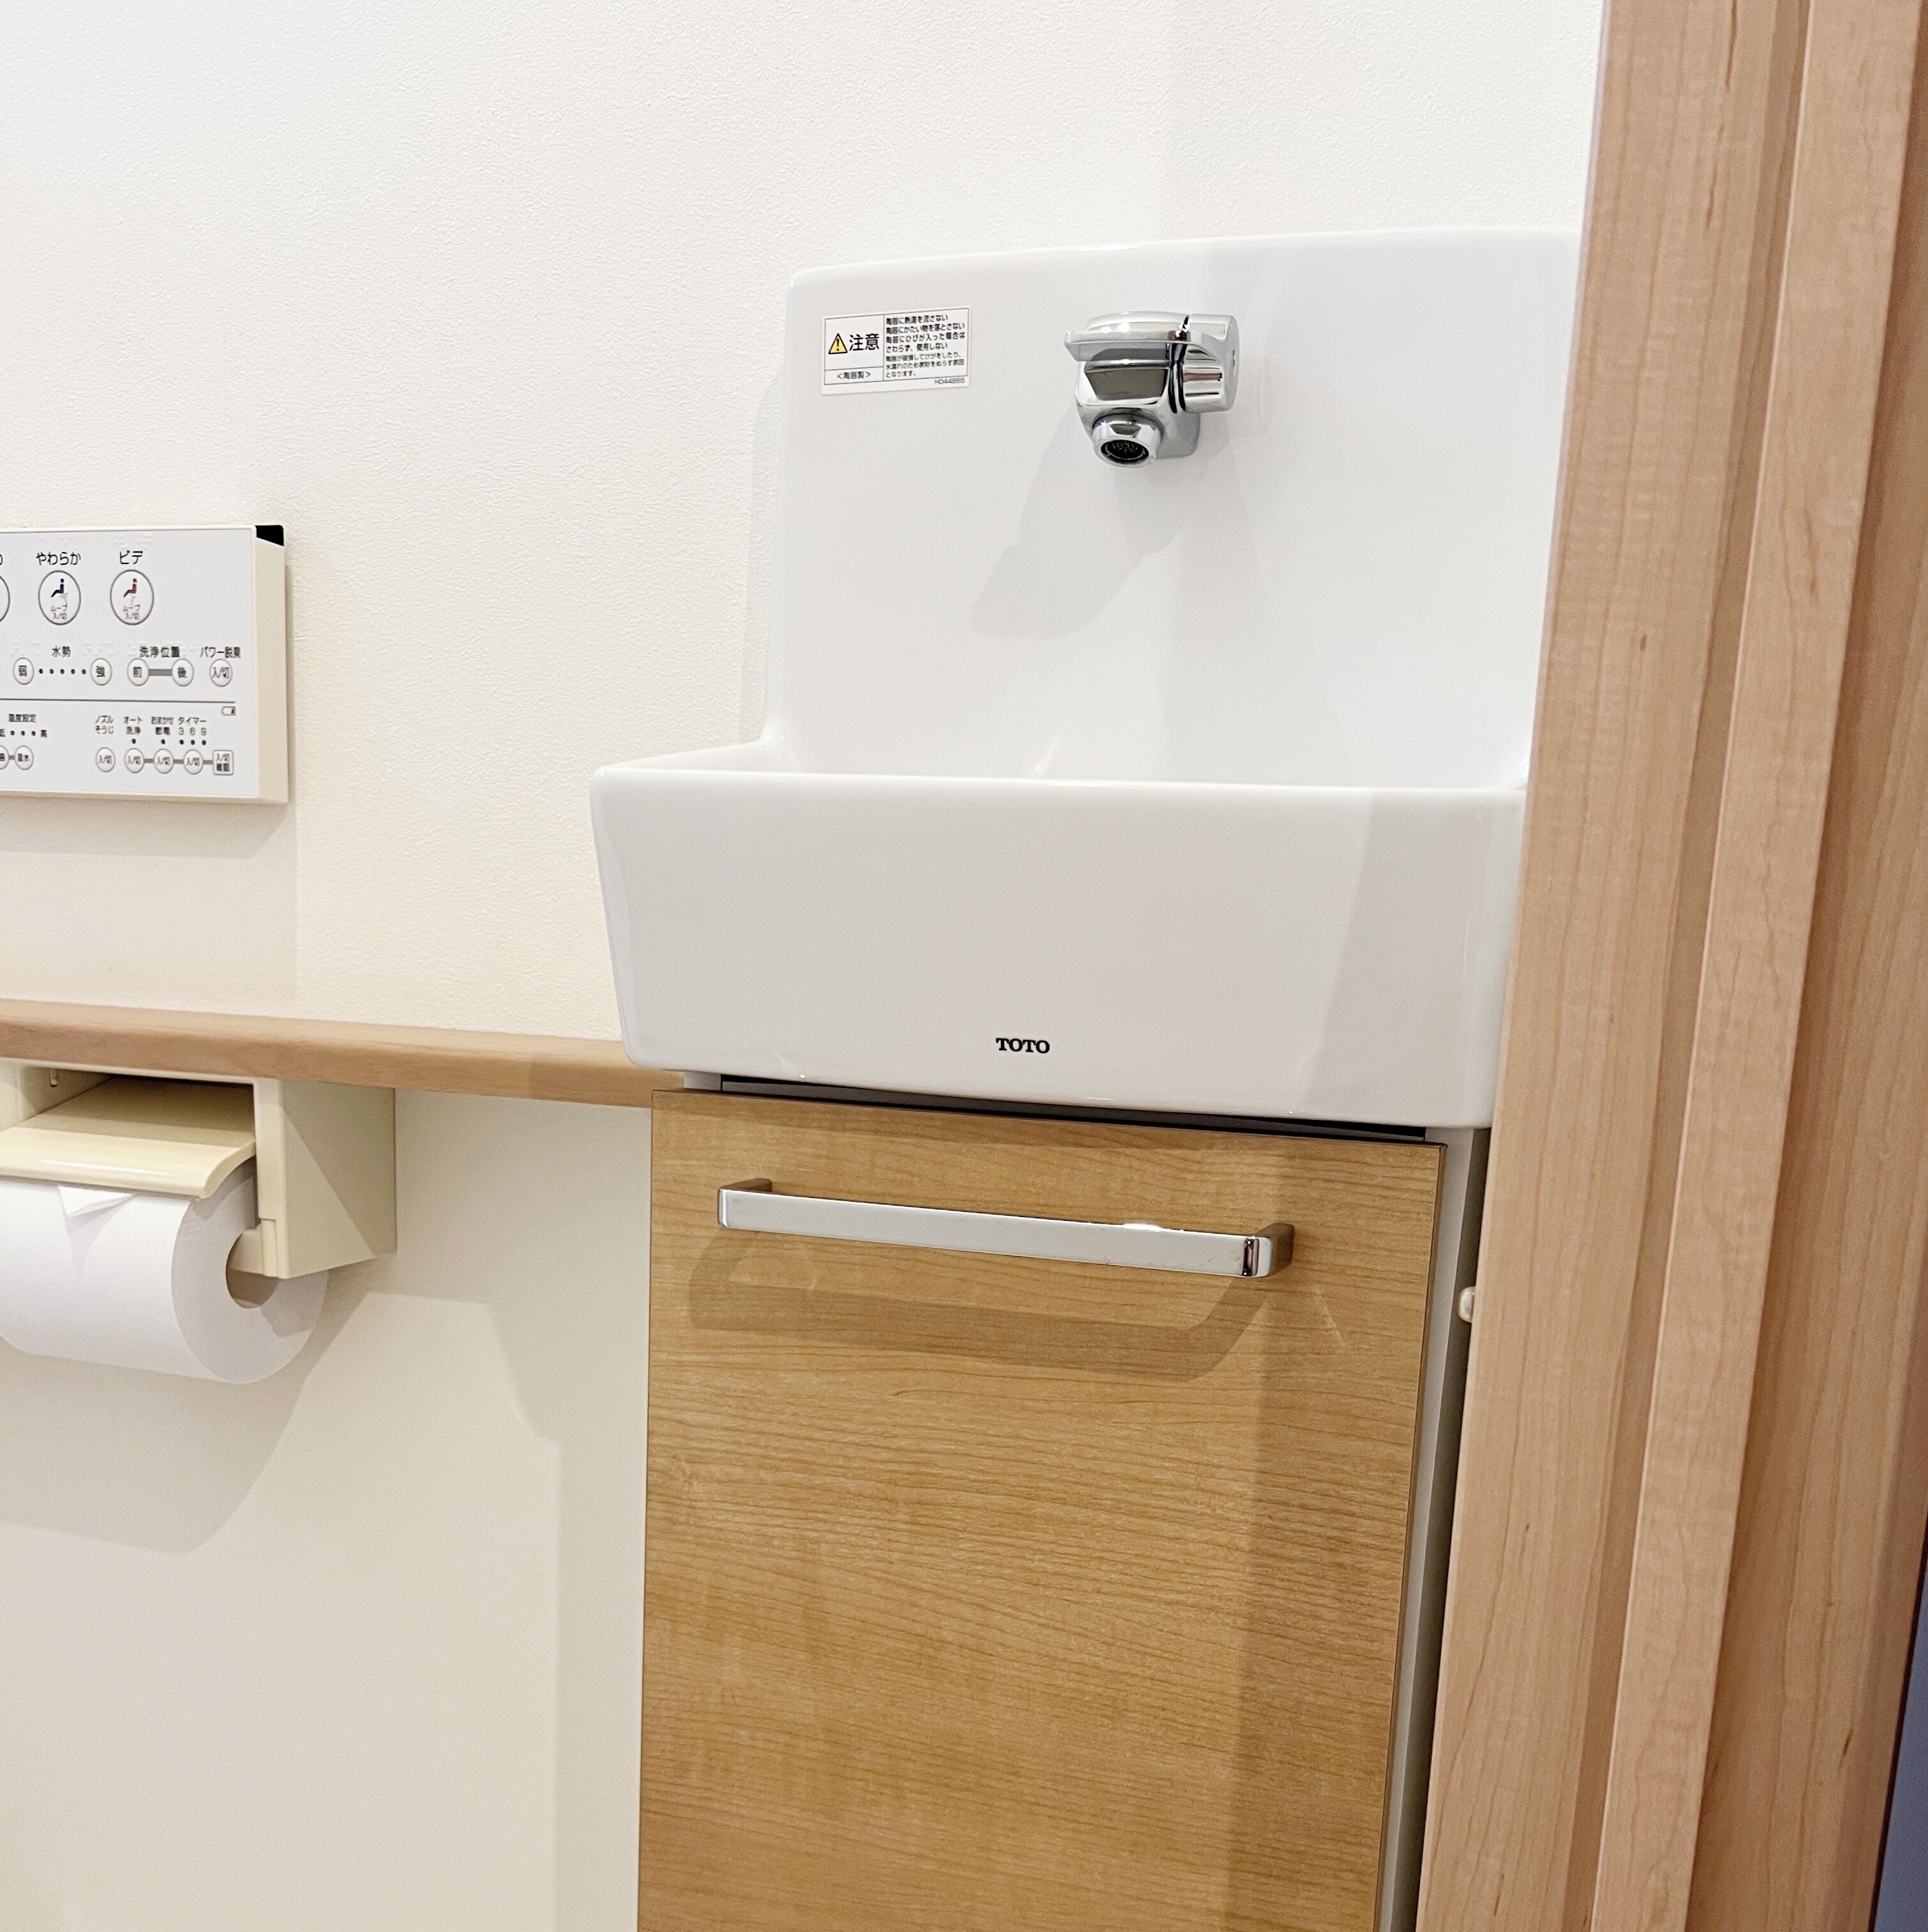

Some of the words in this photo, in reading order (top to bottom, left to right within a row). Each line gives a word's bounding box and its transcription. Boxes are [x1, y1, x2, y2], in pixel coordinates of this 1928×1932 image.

[849, 333, 879, 351] 注意
[886, 332, 965, 343] 陶器にひびが入った場合は
[36, 552, 81, 565] やわらか
[120, 550, 143, 565] ビデ
[52, 646, 71, 657] 水勢
[139, 646, 180, 658] 洗浄位置
[200, 646, 241, 659] パワー脱臭
[96, 666, 105, 677] 強
[133, 666, 142, 678] 前
[178, 666, 187, 678] 後
[95, 715, 114, 723] ノズル
[124, 716, 143, 725] オート
[178, 717, 206, 725] タイマー
[95, 725, 114, 735] そうじ
[178, 727, 184, 735] 3
[190, 727, 195, 735] 6
[996, 1038, 1050, 1054] TOTO
